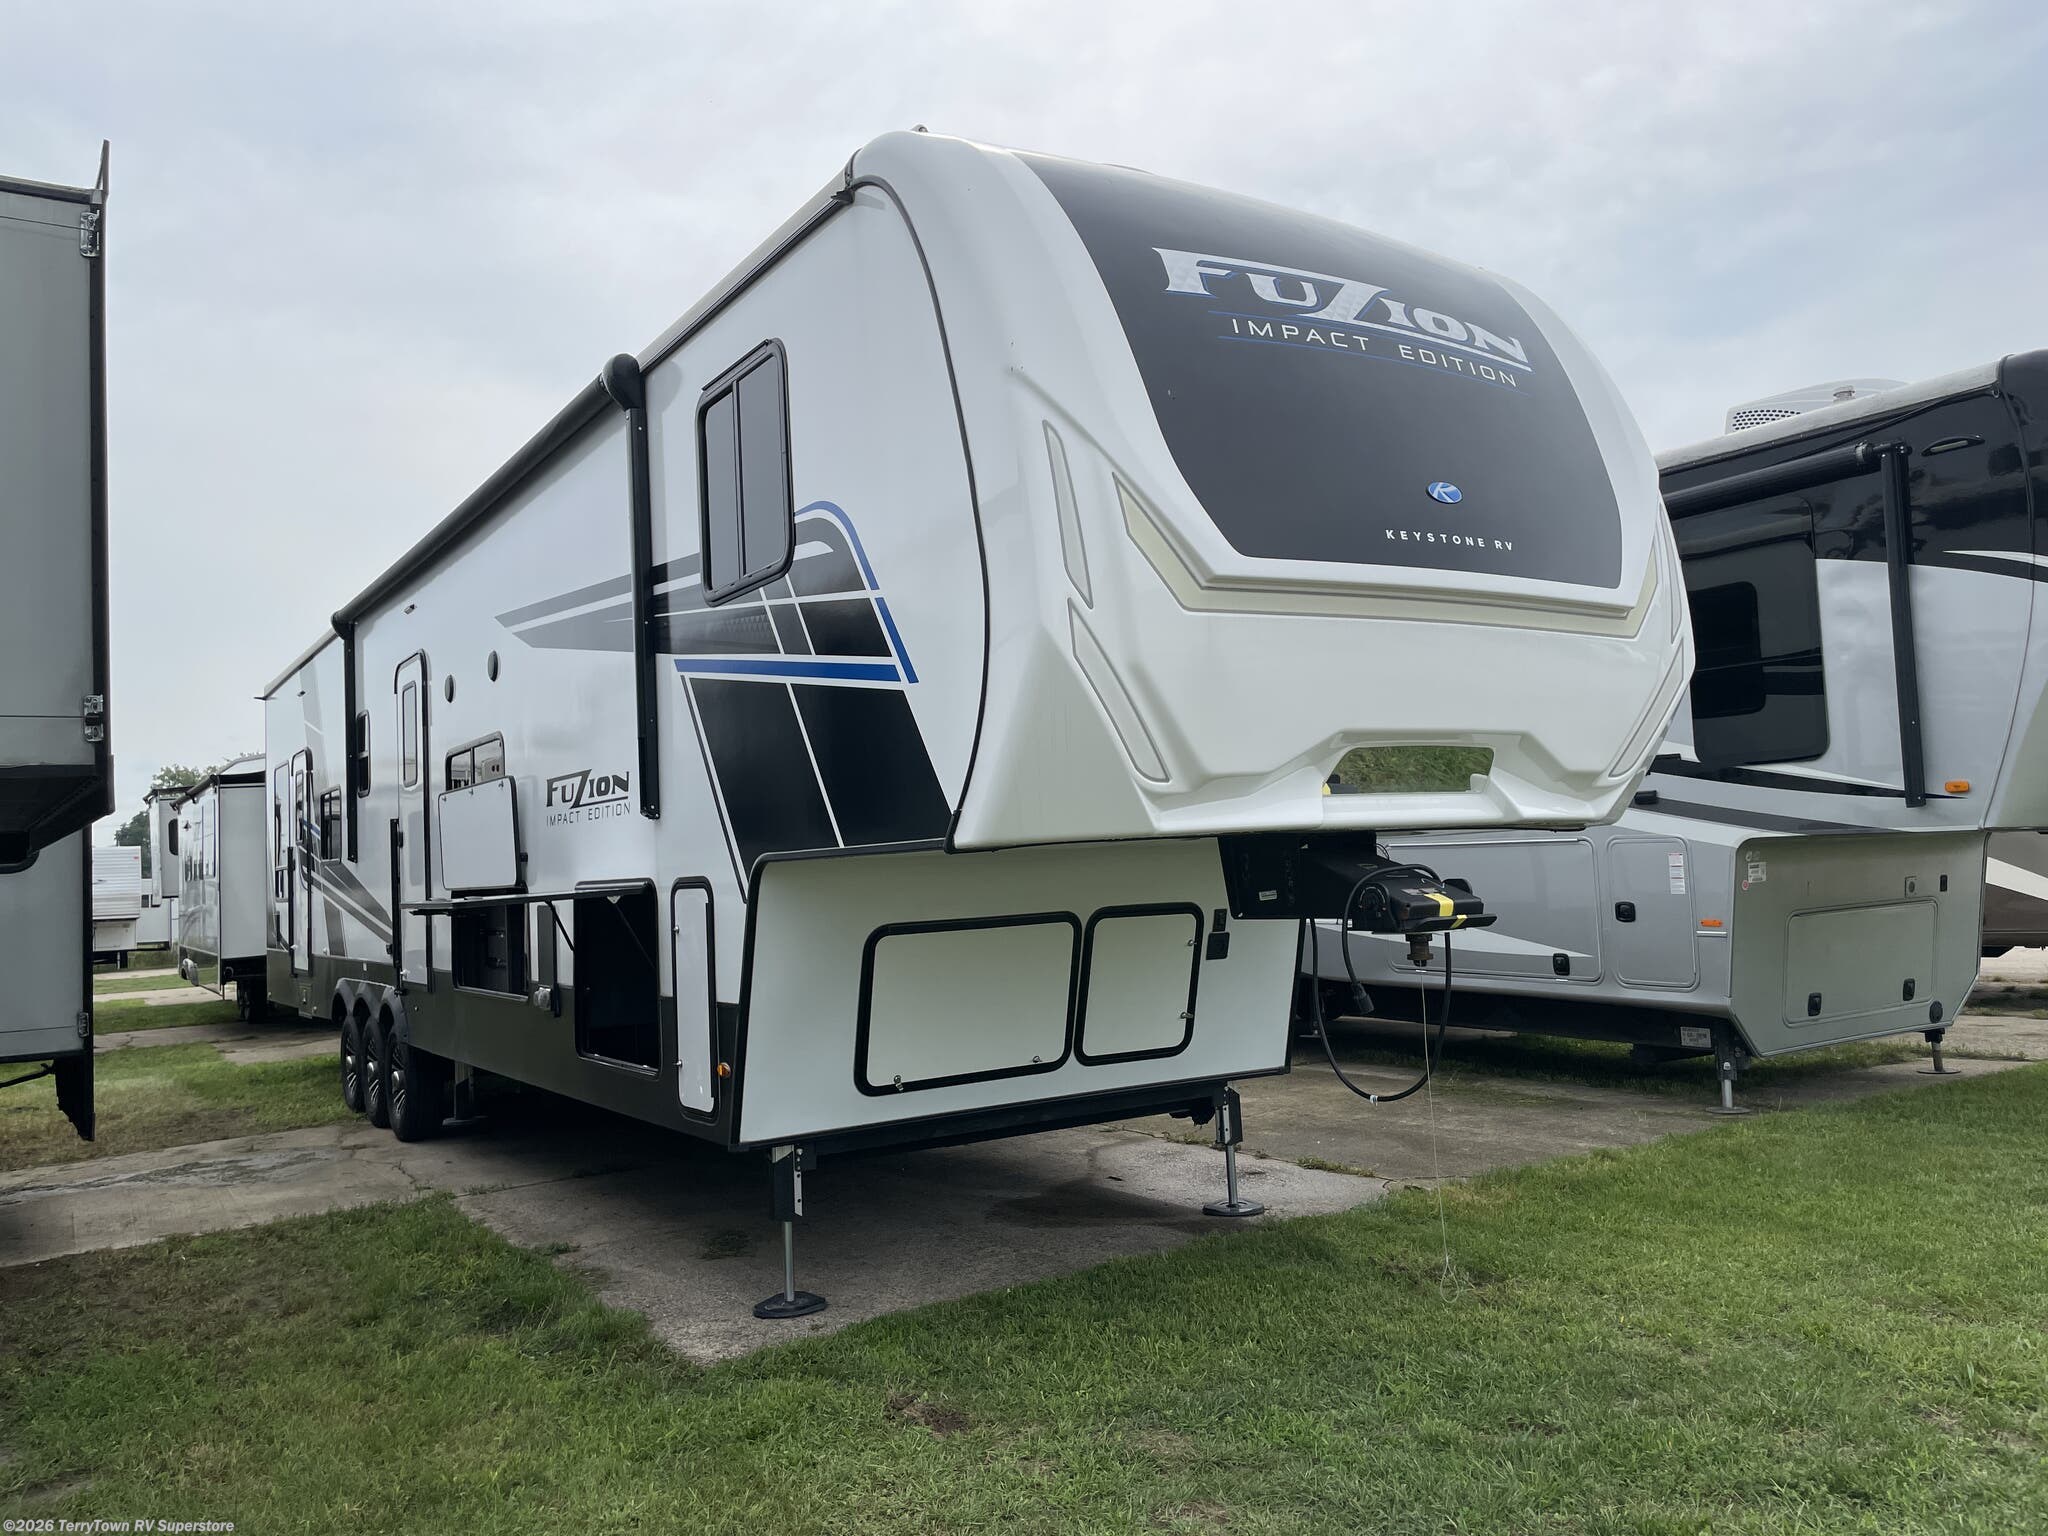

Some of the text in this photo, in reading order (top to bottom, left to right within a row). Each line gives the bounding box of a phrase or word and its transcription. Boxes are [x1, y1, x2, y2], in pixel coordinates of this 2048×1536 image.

[1232, 319, 1517, 387] IMPACT EDITION
[1386, 529, 1512, 551] KEYSTONE RV
[546, 802, 631, 827] IMPACT EDITION
